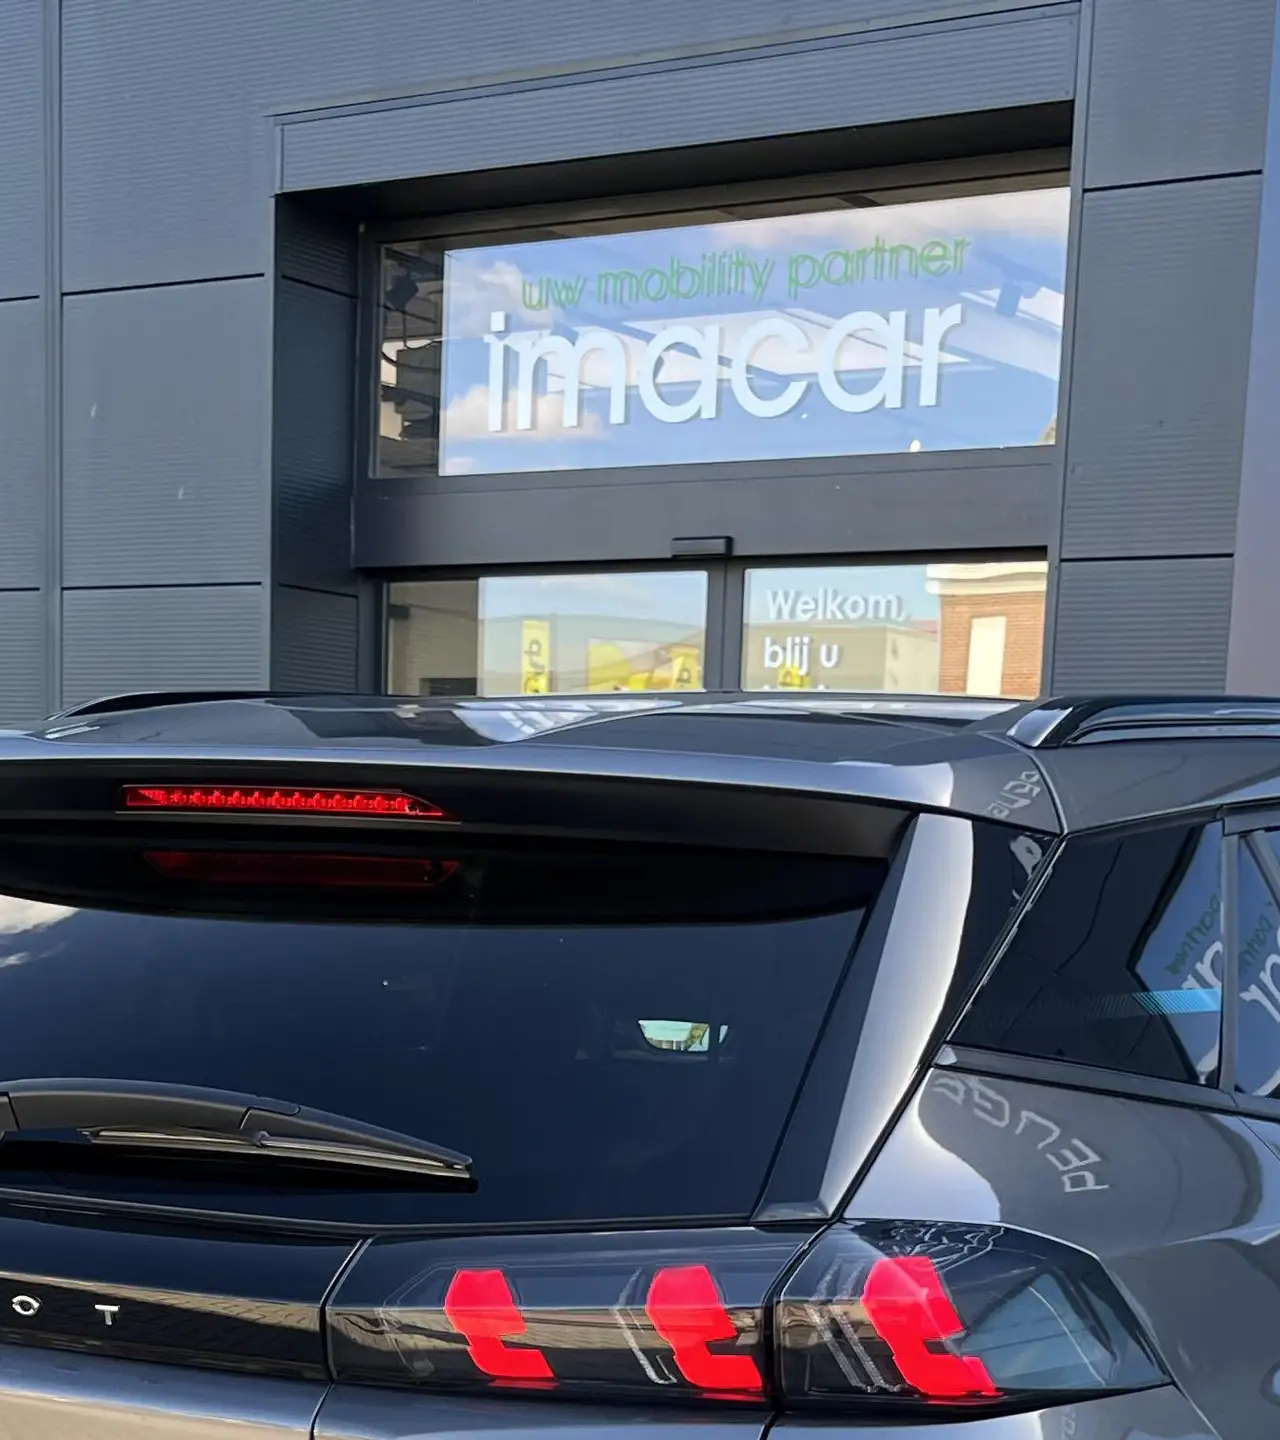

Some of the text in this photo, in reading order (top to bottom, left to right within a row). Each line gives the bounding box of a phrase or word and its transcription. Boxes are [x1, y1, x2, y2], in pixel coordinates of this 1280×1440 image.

[522, 235, 972, 312] uw mobility partner
[483, 302, 962, 433] imacar
[762, 635, 840, 676] blij u
